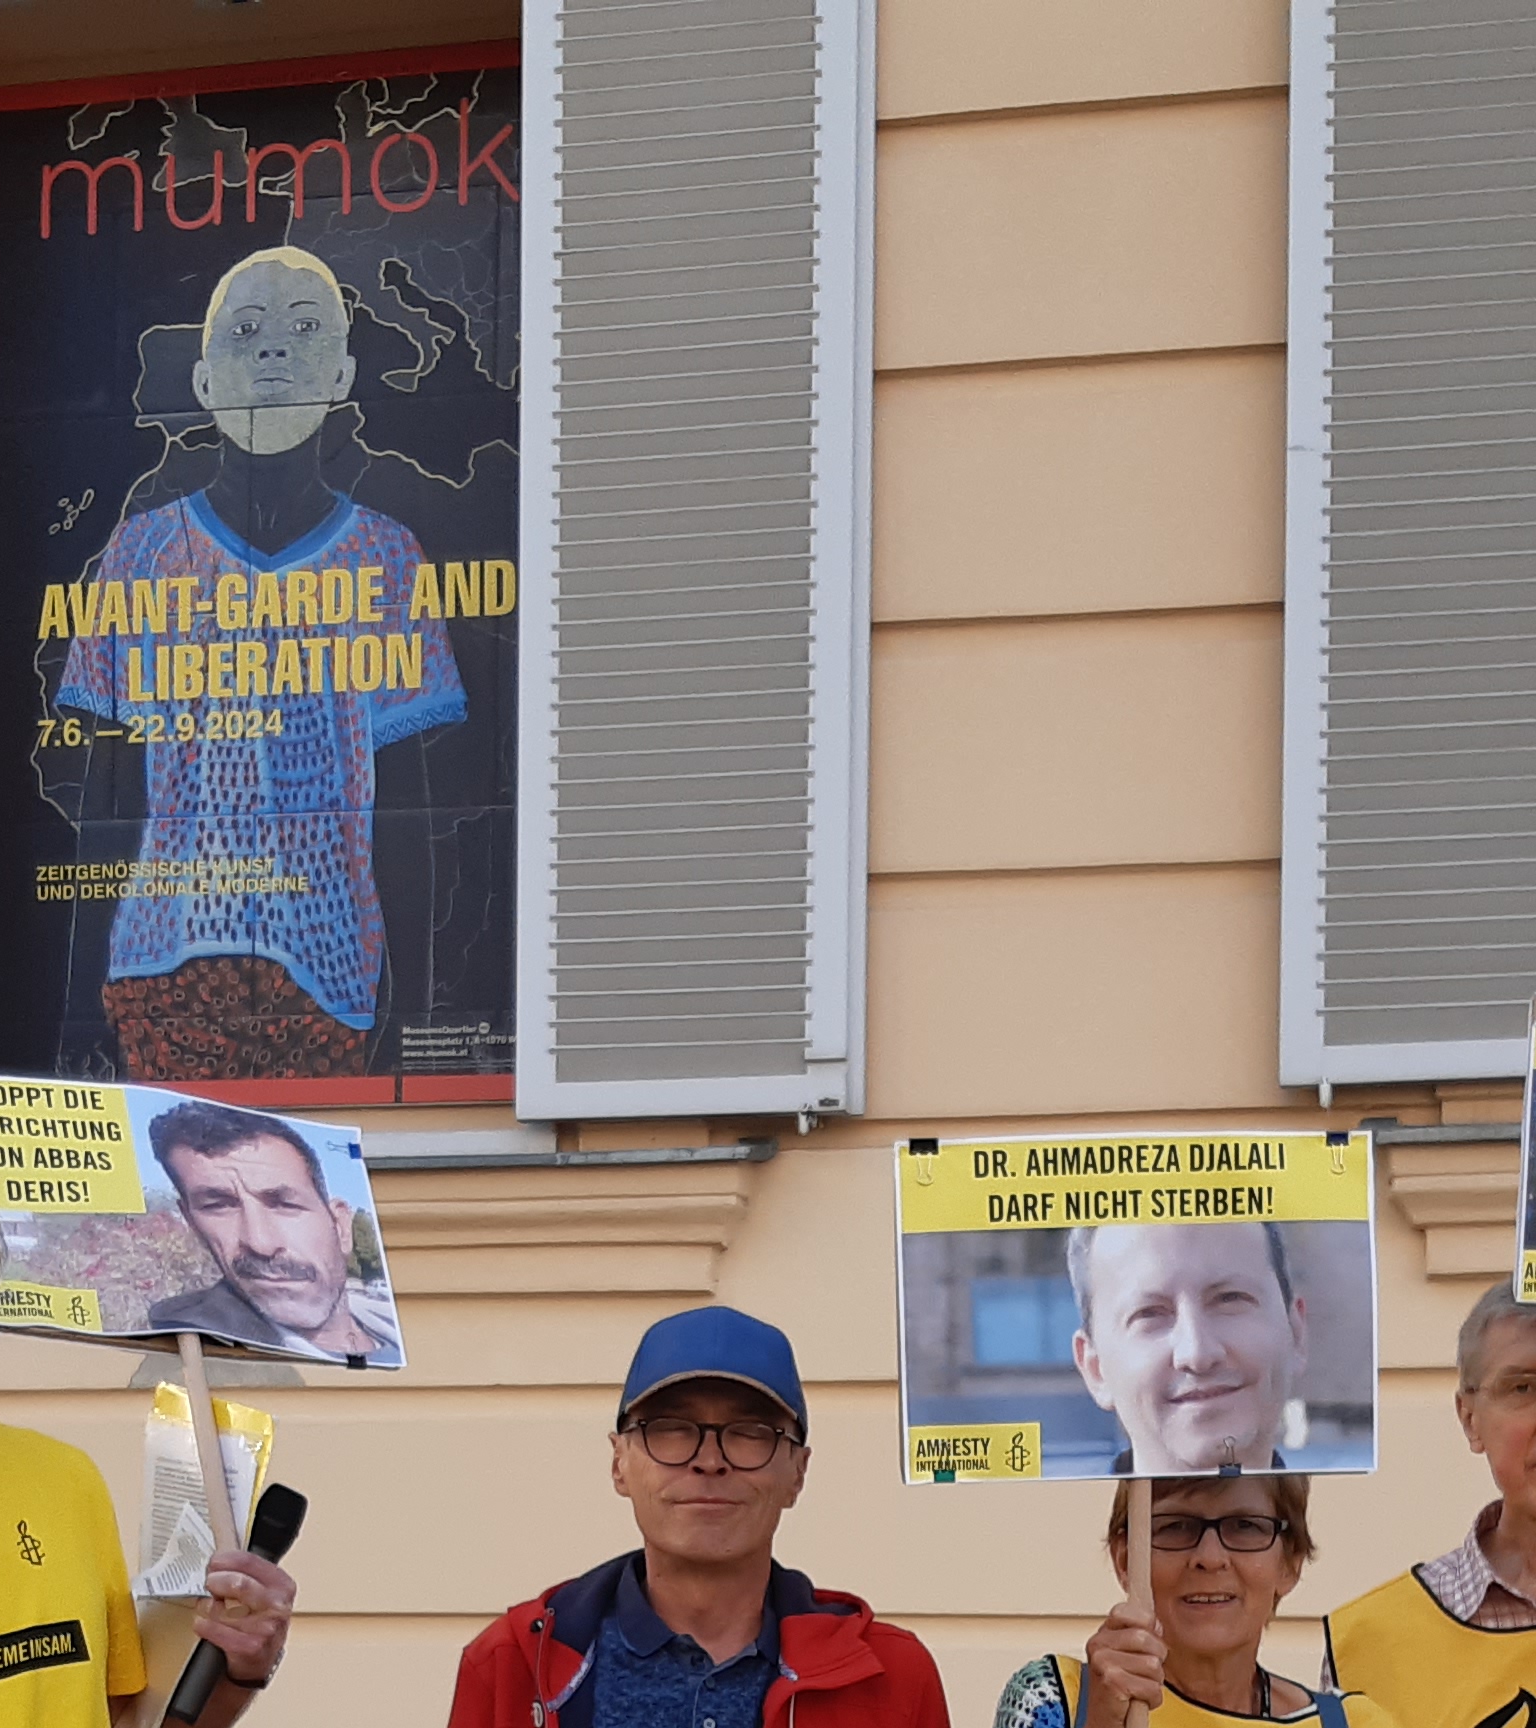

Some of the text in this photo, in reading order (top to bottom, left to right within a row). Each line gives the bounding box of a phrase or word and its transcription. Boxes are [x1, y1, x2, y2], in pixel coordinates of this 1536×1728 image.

[41, 98, 519, 239] mumok
[37, 559, 517, 640] AVANT-GARDE AND
[127, 634, 423, 703] LIBERATION
[35, 858, 276, 882] ZEITGENÖSSISCHE KUNST
[36, 876, 310, 901] UND DEKOLONIALE MODERNE
[63, 1088, 105, 1111] DIE
[33, 1145, 113, 1172] ABBAS
[973, 1142, 1286, 1180] DR. AHMADREZA DJALALI
[6, 1178, 91, 1204] DERIS!
[988, 1186, 1275, 1224] DARF NICHT STERBEN!
[915, 1437, 991, 1458] AMNESTY
[915, 1458, 991, 1472] INTERNATIONAL
